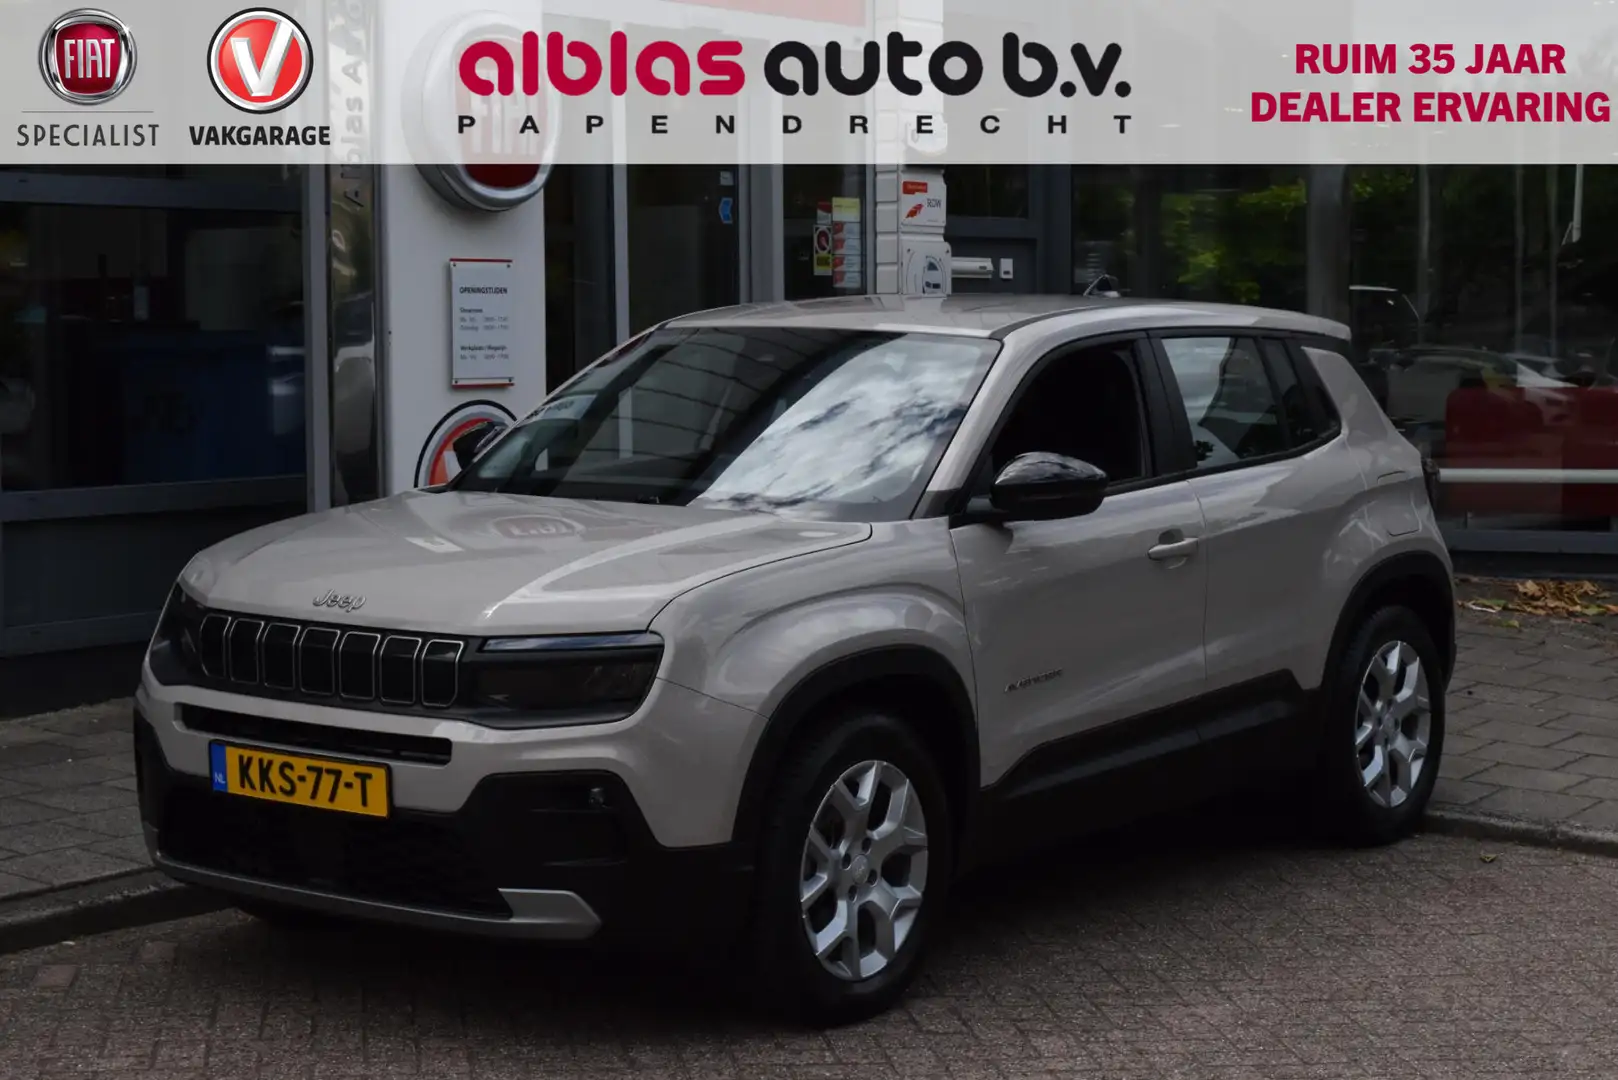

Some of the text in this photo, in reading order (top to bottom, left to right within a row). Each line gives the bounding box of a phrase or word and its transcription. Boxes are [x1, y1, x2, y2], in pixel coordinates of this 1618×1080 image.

[313, 589, 366, 612] Jeep
[214, 773, 226, 784] NL
[238, 754, 373, 807] KKS-77-T
